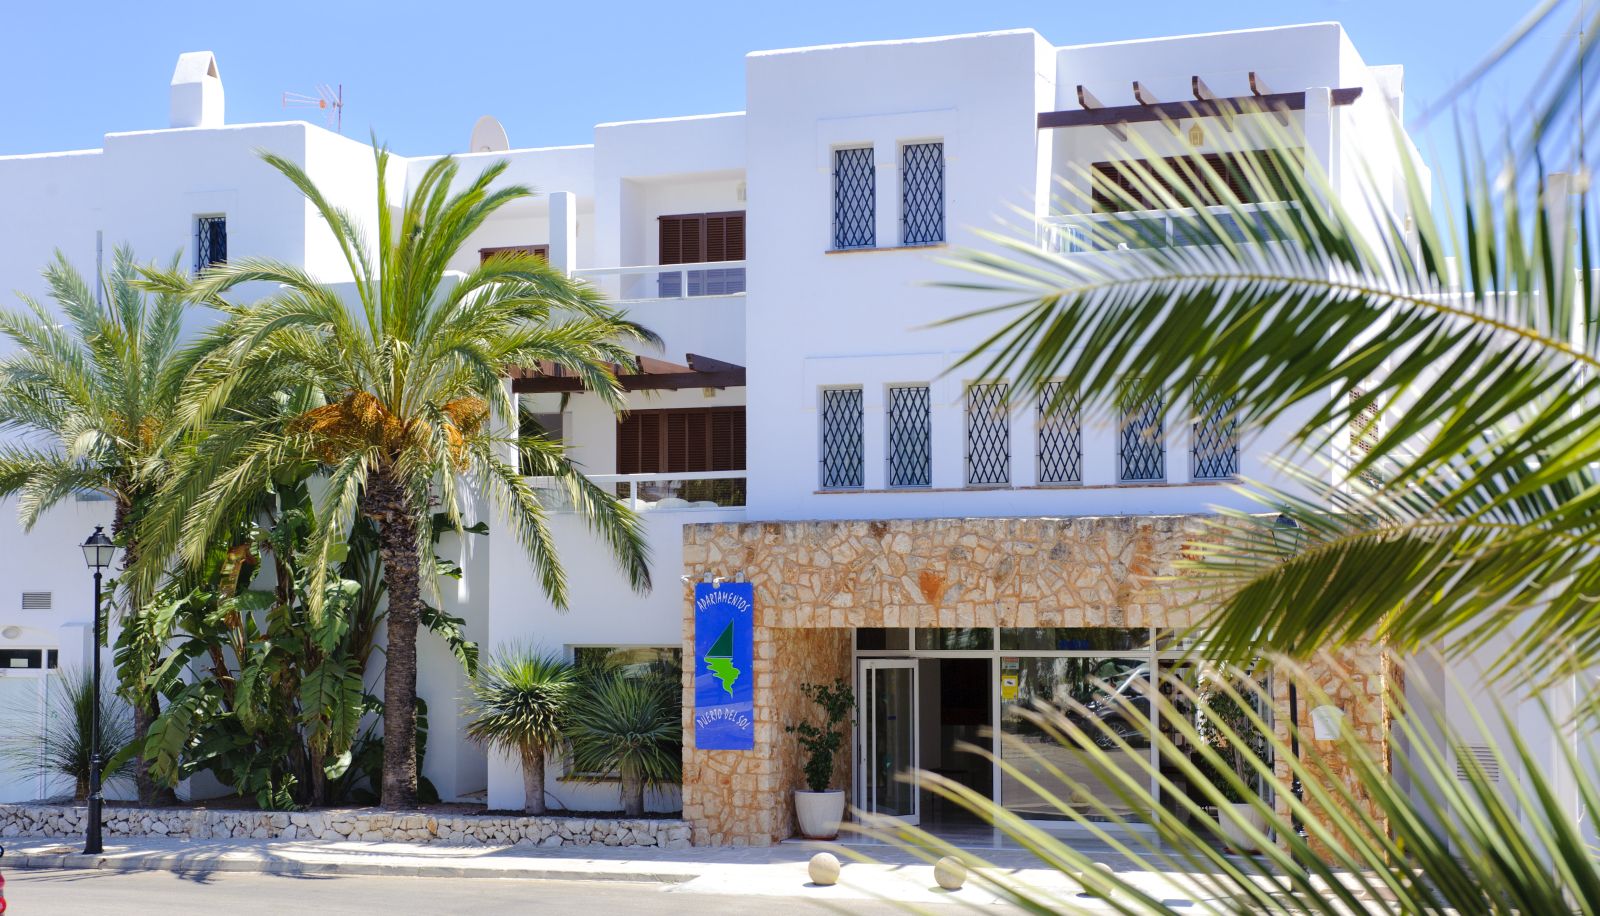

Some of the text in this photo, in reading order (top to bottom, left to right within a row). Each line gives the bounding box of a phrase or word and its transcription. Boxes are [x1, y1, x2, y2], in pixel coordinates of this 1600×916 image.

[696, 590, 751, 612] APARTAMENTOS
[696, 707, 751, 730] PUERTO DEL SOL
